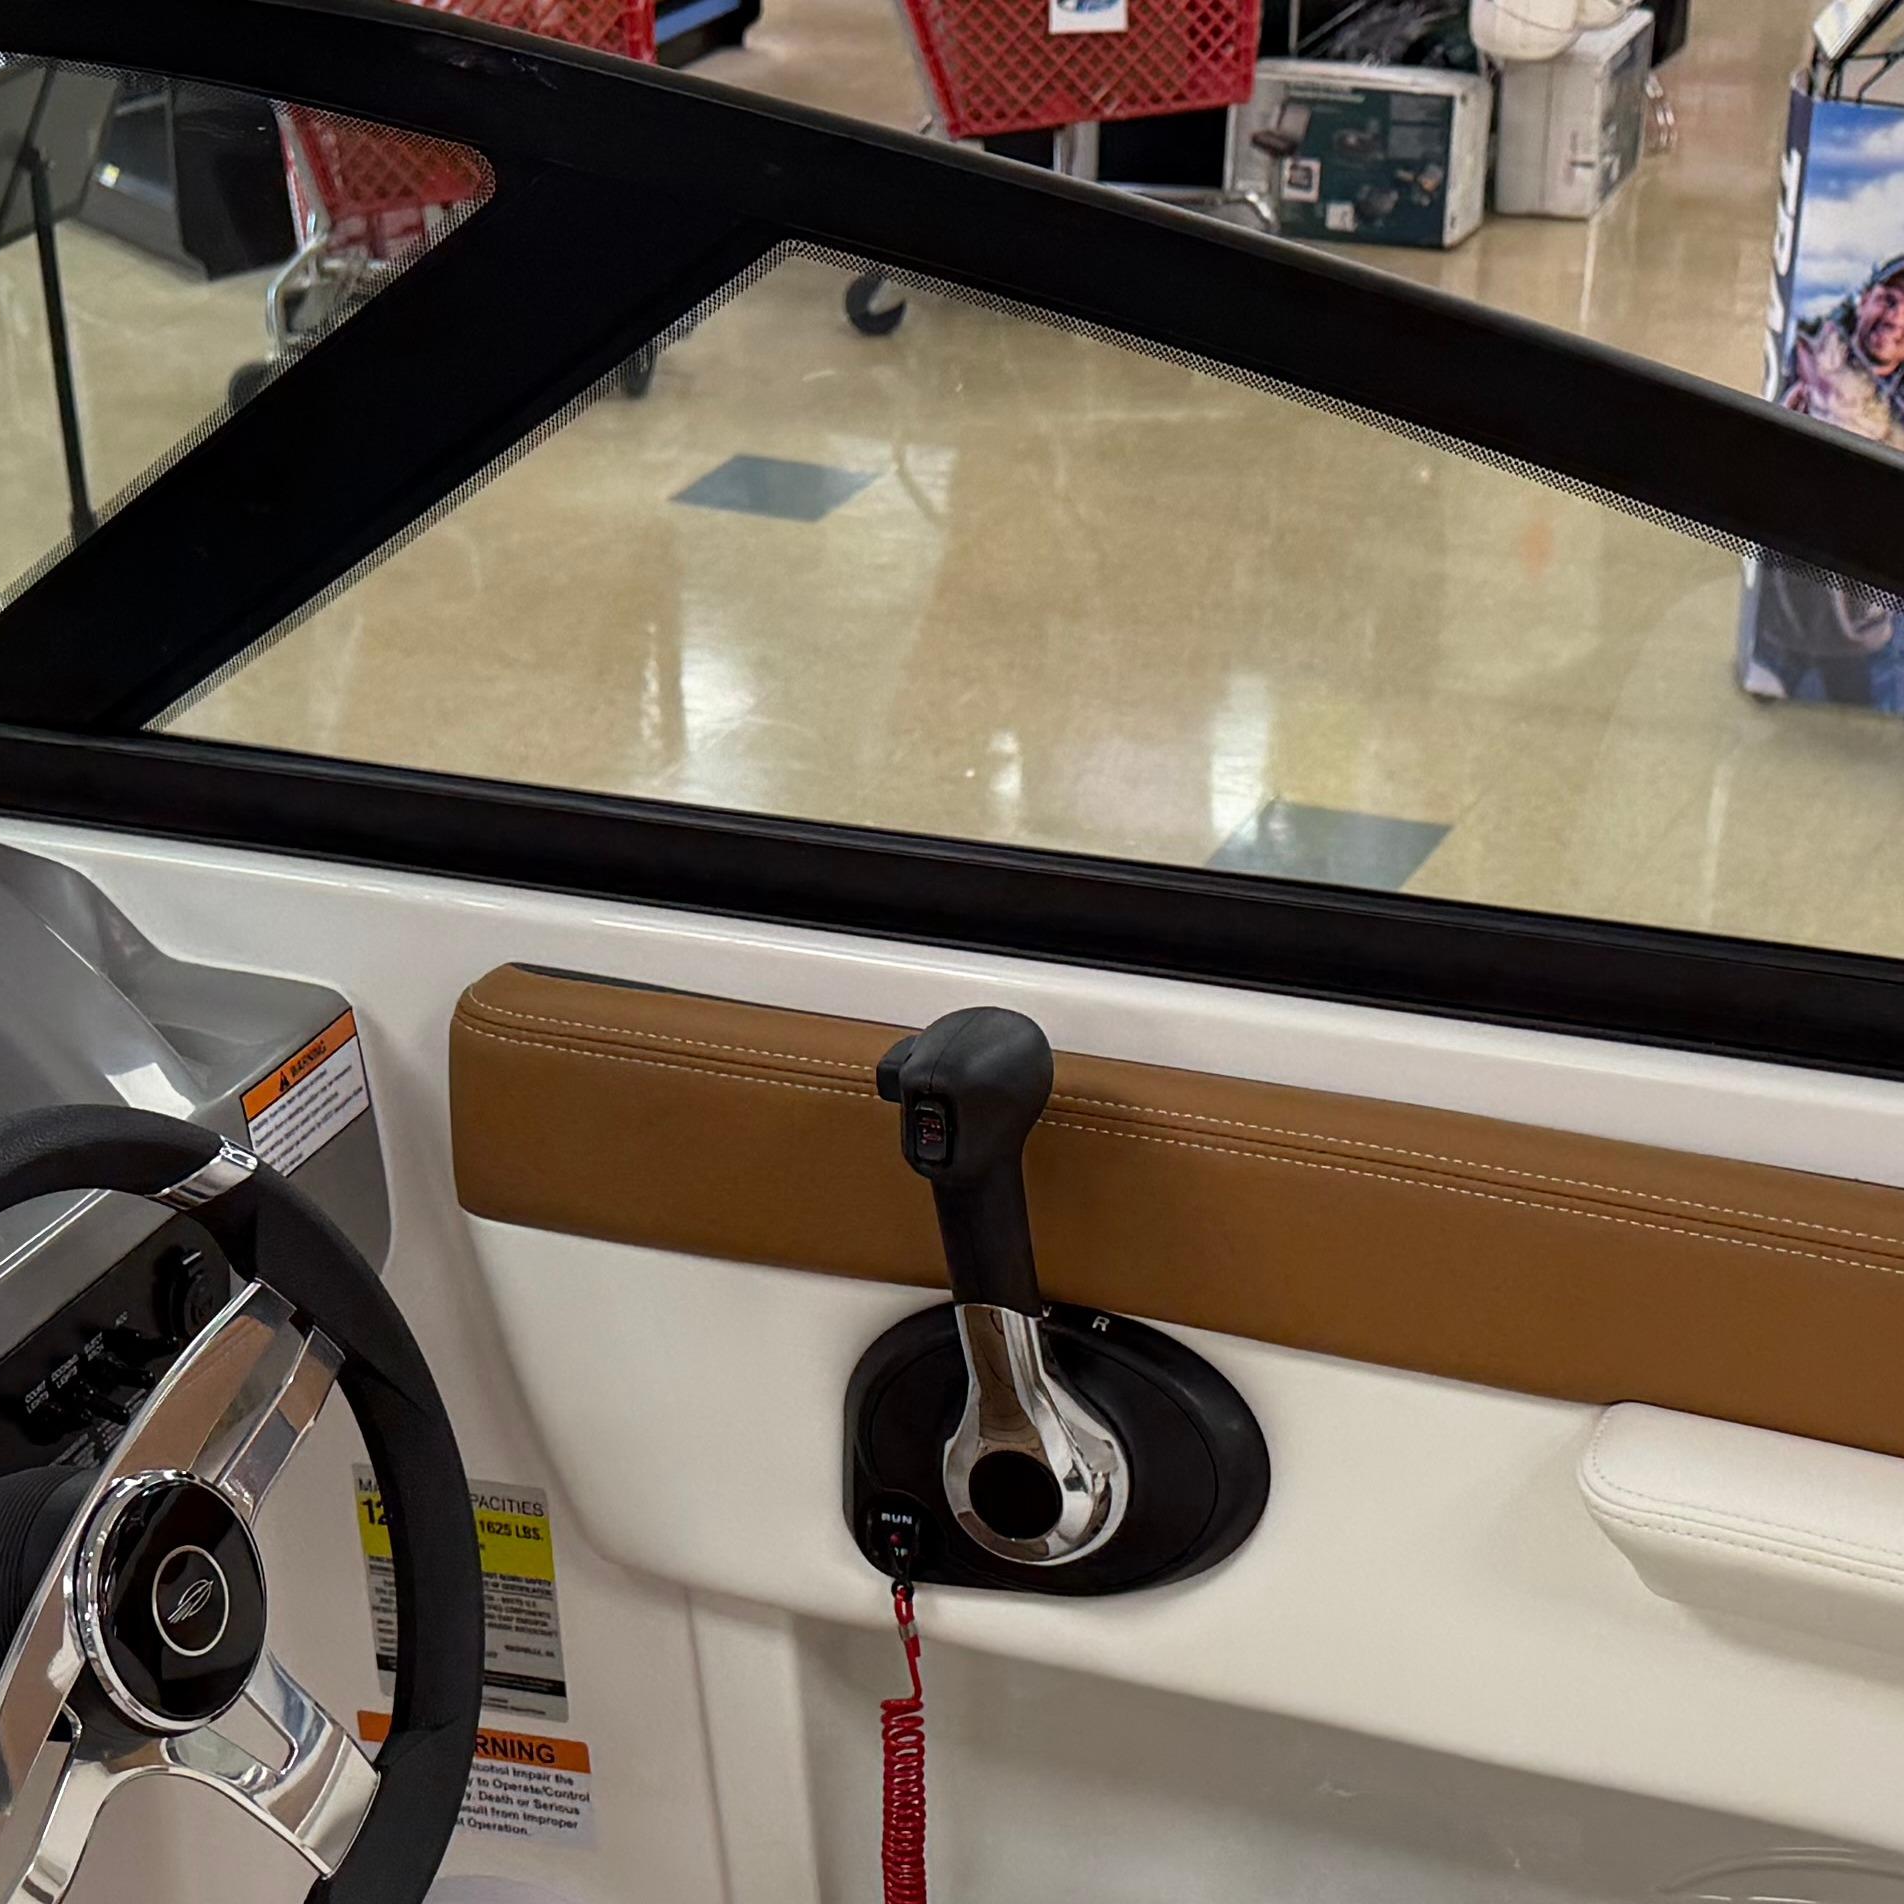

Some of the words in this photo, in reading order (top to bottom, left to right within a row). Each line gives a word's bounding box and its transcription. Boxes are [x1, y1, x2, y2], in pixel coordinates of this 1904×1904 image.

[1092, 1316, 1110, 1332] R
[56, 1366, 77, 1389] LIGHTS
[470, 1494, 544, 1517] PACITIES
[881, 1512, 912, 1525] RUN
[479, 1519, 512, 1537] 1625
[515, 1523, 544, 1541] LBS.
[475, 1733, 555, 1764] RNING
[512, 1768, 551, 1782] Impair
[554, 1773, 573, 1785] the
[477, 1791, 513, 1805] Death
[517, 1799, 529, 1807] or
[532, 1799, 579, 1815] Serious
[467, 1818, 530, 1835] Operation.
[490, 1807, 519, 1820] from
[523, 1812, 577, 1829] Improper
